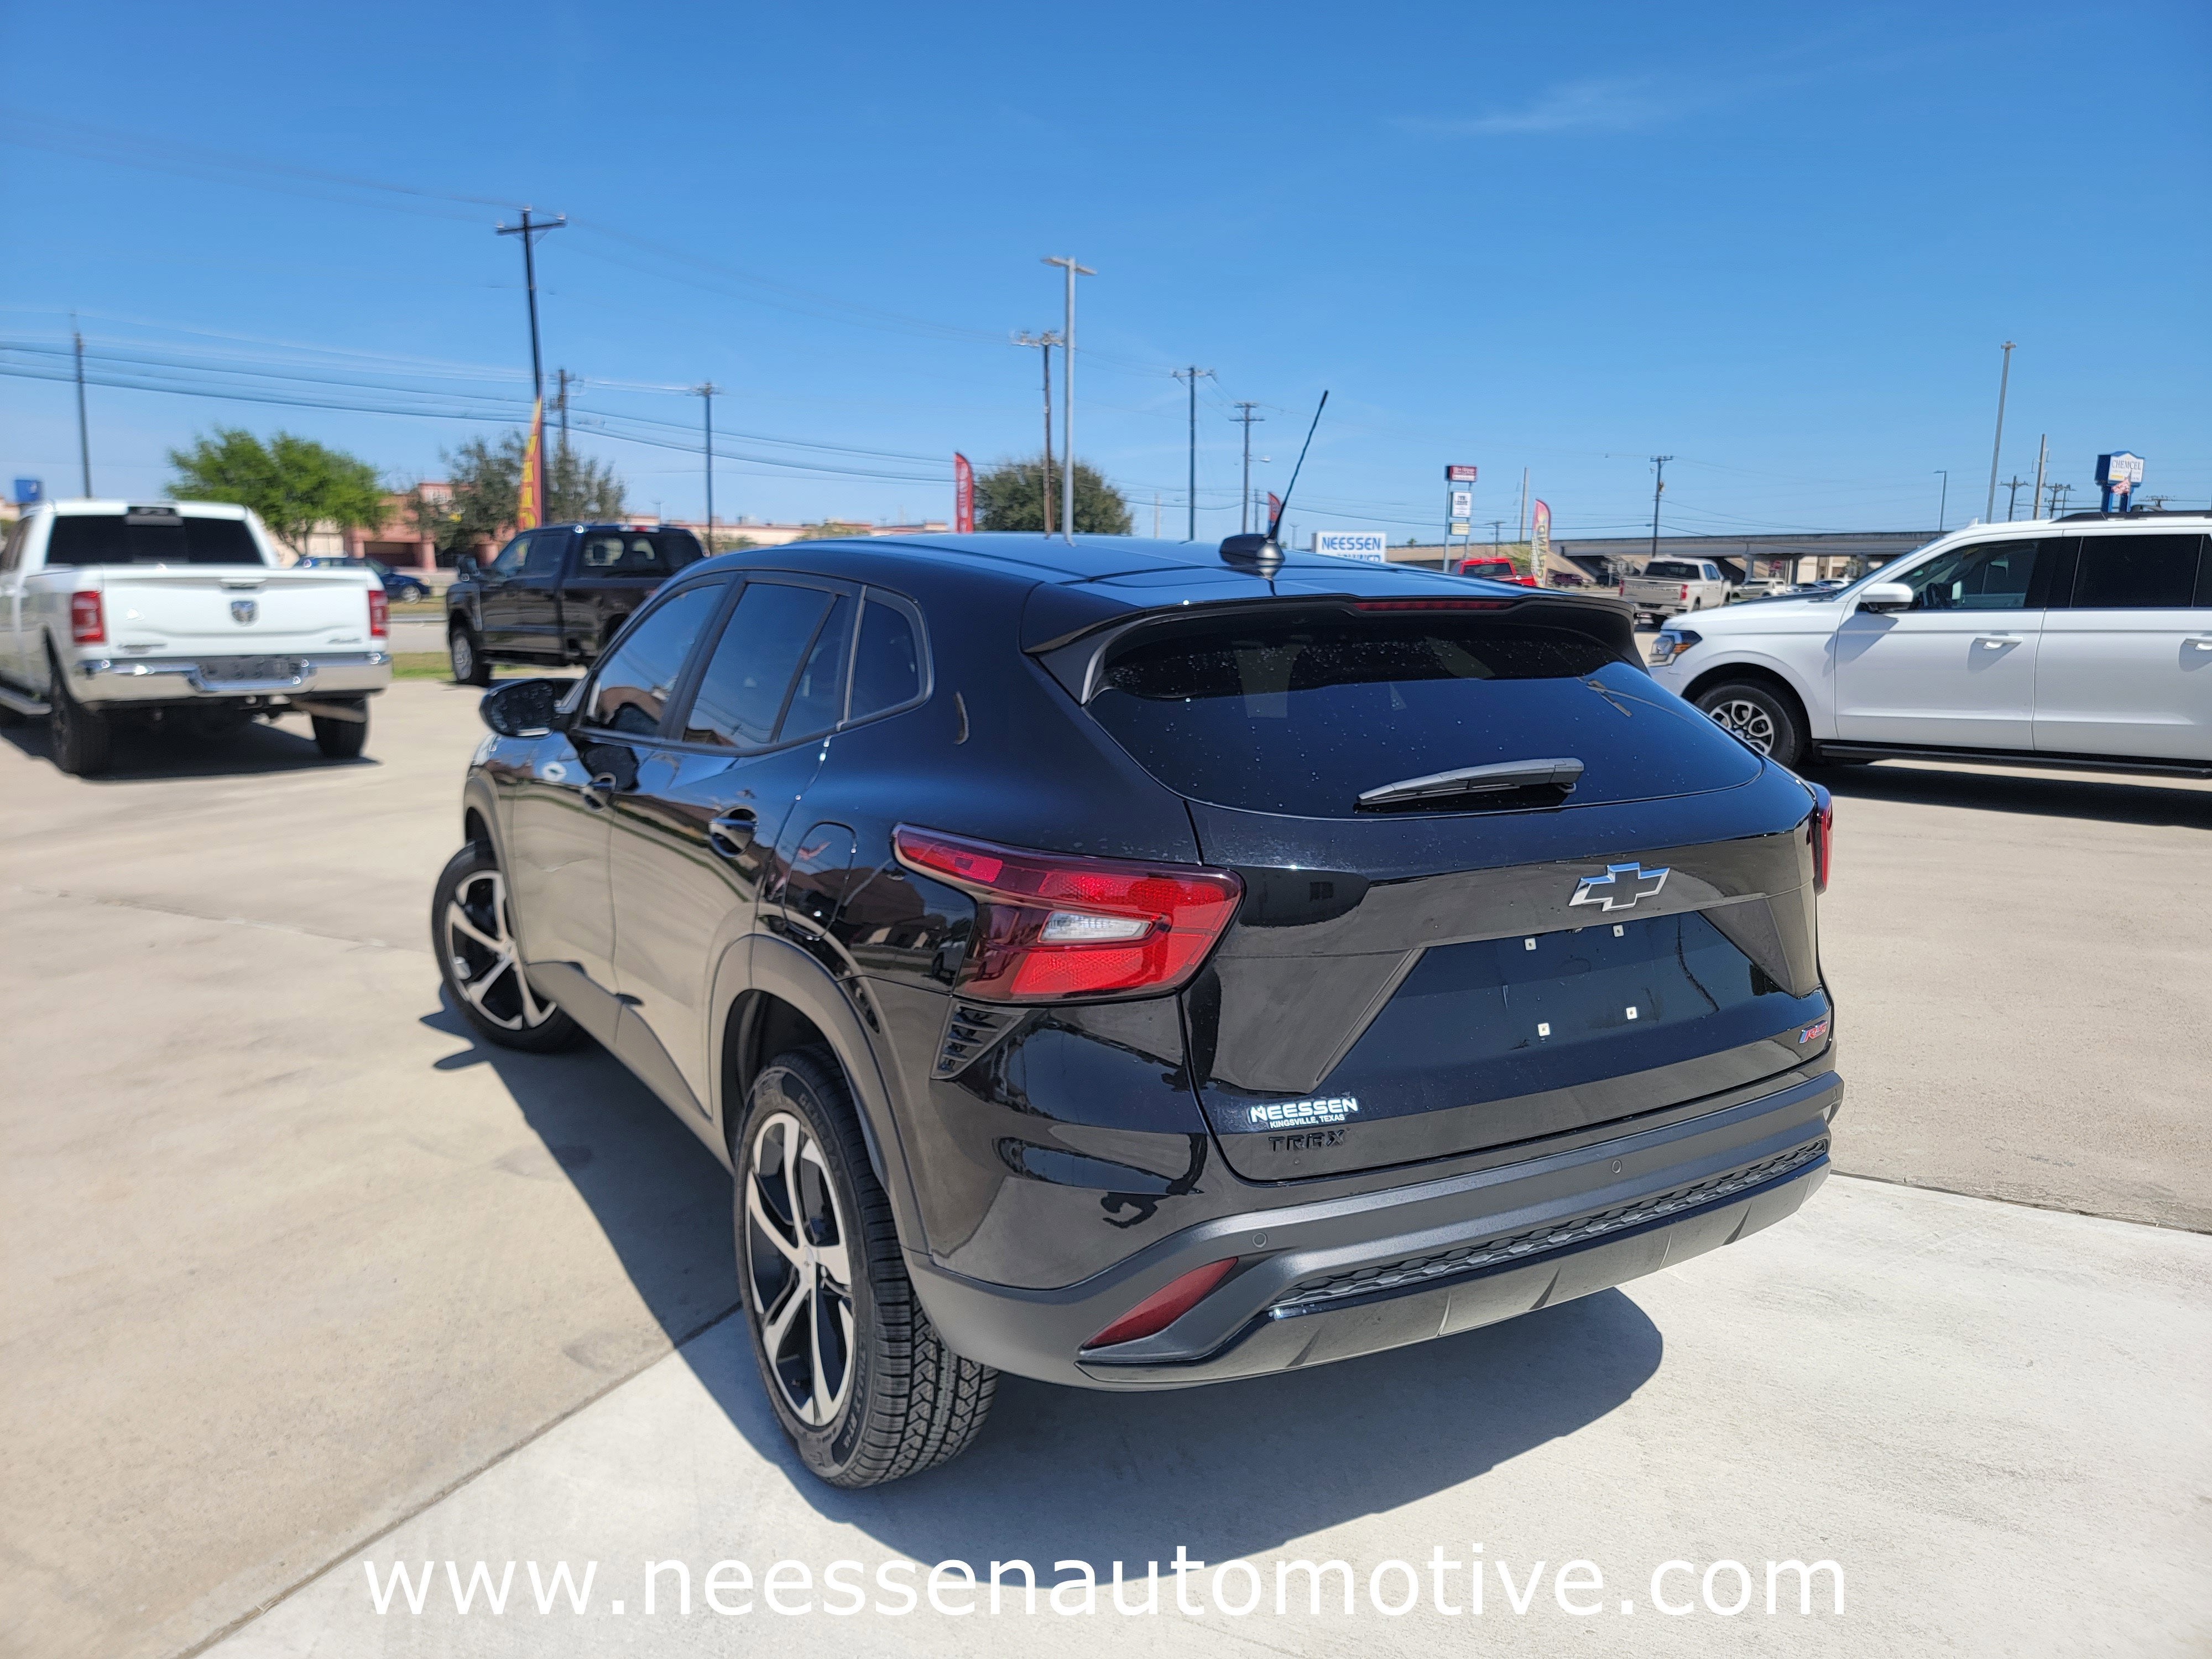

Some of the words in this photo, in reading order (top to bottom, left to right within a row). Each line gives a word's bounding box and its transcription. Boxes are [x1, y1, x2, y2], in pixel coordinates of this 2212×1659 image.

[1321, 536, 1381, 550] NEESSEN
[1250, 1097, 1359, 1123] NEESSEN
[1269, 1115, 1319, 1129] KINGSVILLE,
[1319, 1113, 1345, 1123] TEXAS
[1268, 1129, 1345, 1152] TRAX
